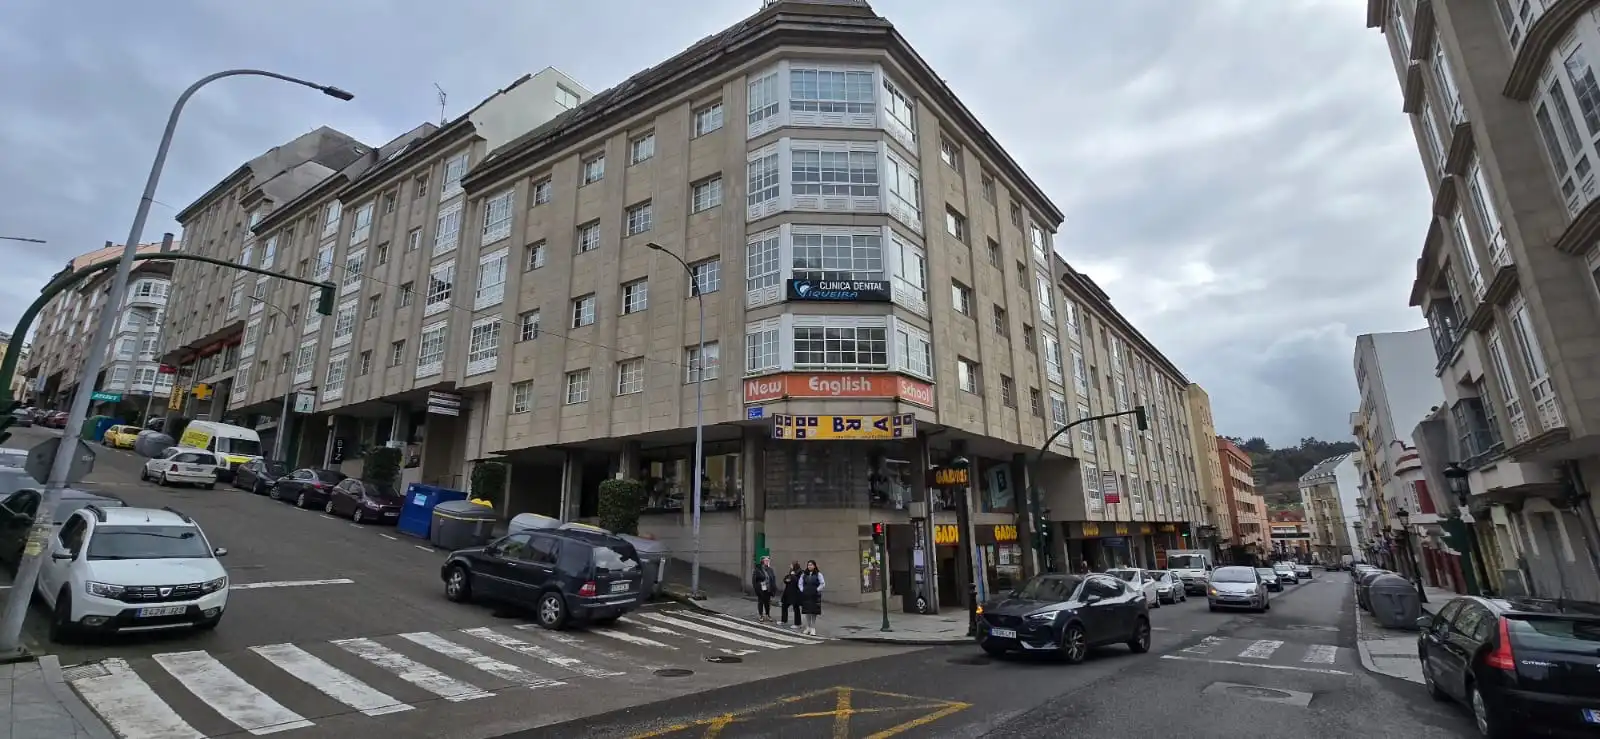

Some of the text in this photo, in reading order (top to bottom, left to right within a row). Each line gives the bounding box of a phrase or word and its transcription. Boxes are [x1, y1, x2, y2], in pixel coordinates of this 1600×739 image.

[819, 281, 884, 291] CLINICA DENTAL
[748, 376, 930, 402] New English School
